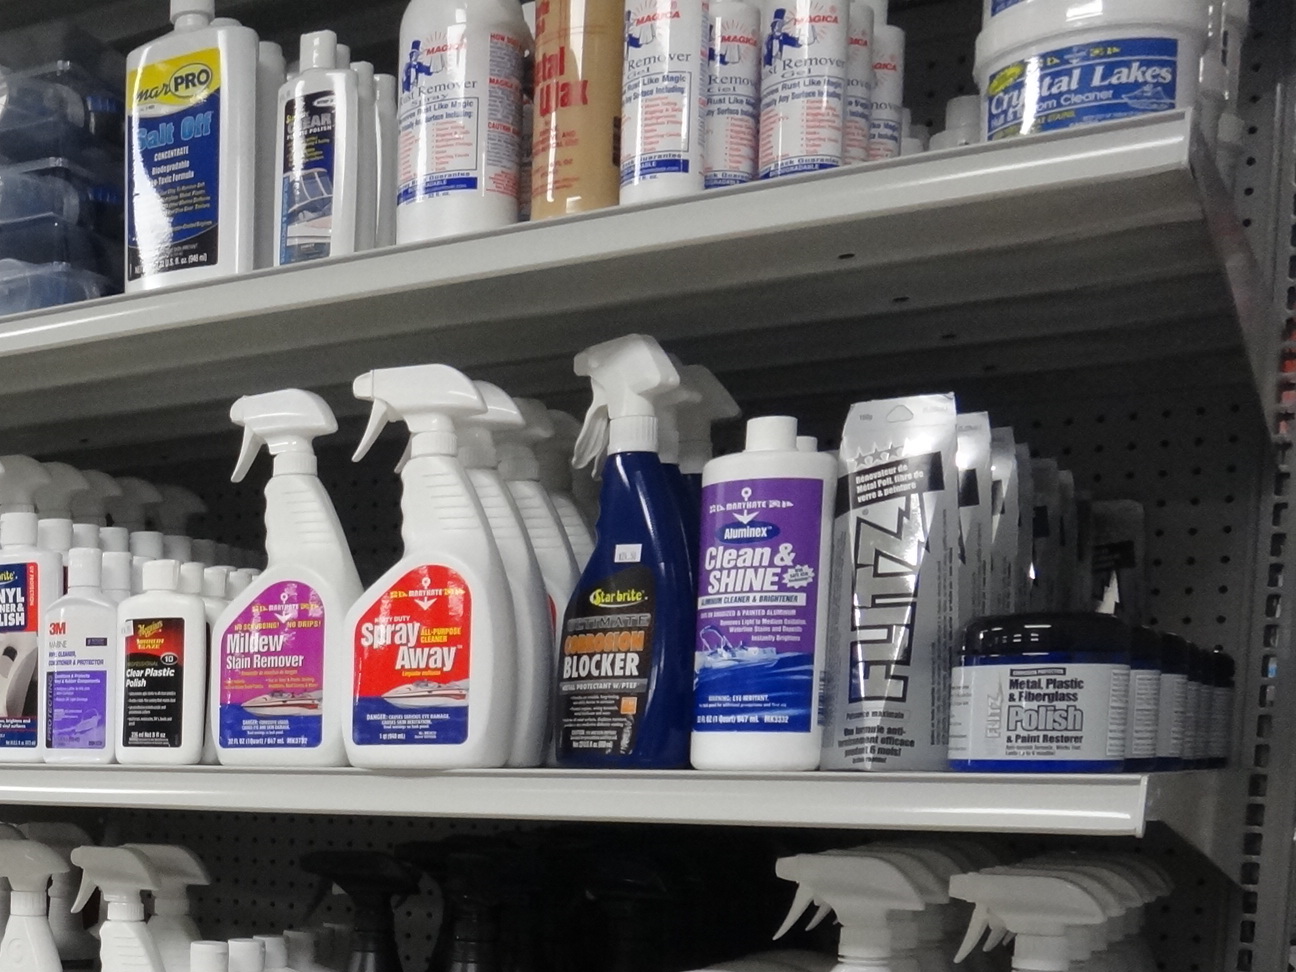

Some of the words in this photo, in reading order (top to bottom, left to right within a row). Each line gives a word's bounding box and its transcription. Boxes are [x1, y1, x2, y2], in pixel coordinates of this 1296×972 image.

[627, 51, 692, 71] Remover
[782, 57, 845, 71] Remover
[990, 65, 1079, 115] Crytal
[1092, 61, 1174, 89] Lakes
[1060, 88, 1114, 106] Cleaner
[181, 111, 211, 140] Off
[154, 146, 189, 162] CONCENTRATE
[724, 527, 768, 540] Aluminex
[704, 546, 771, 571] Clean
[774, 542, 796, 567] &
[708, 568, 782, 594] SHINE
[848, 480, 932, 703] FLITZ
[723, 596, 751, 605] CLEANER
[758, 595, 799, 603] BRIGHTENER
[49, 621, 67, 636] 3M
[568, 614, 651, 630] ULTIMATE
[361, 622, 421, 650] Spray
[421, 627, 462, 636] ALL-PURPOSE
[226, 633, 284, 654] Mildew
[565, 631, 645, 656] CORROSION
[164, 654, 174, 663] 10
[226, 656, 251, 670] Stain
[253, 655, 304, 669] Remover
[395, 645, 457, 672] Away
[564, 653, 640, 679] BLOCKER
[126, 668, 144, 678] Clear
[145, 667, 175, 677] Plastic
[126, 678, 147, 688] Polish
[1046, 677, 1084, 690] Plastic
[1018, 690, 1079, 704] Fiberglass
[1007, 704, 1084, 732] Polish
[1015, 733, 1040, 744] Paint
[1042, 733, 1084, 744] Restorer
